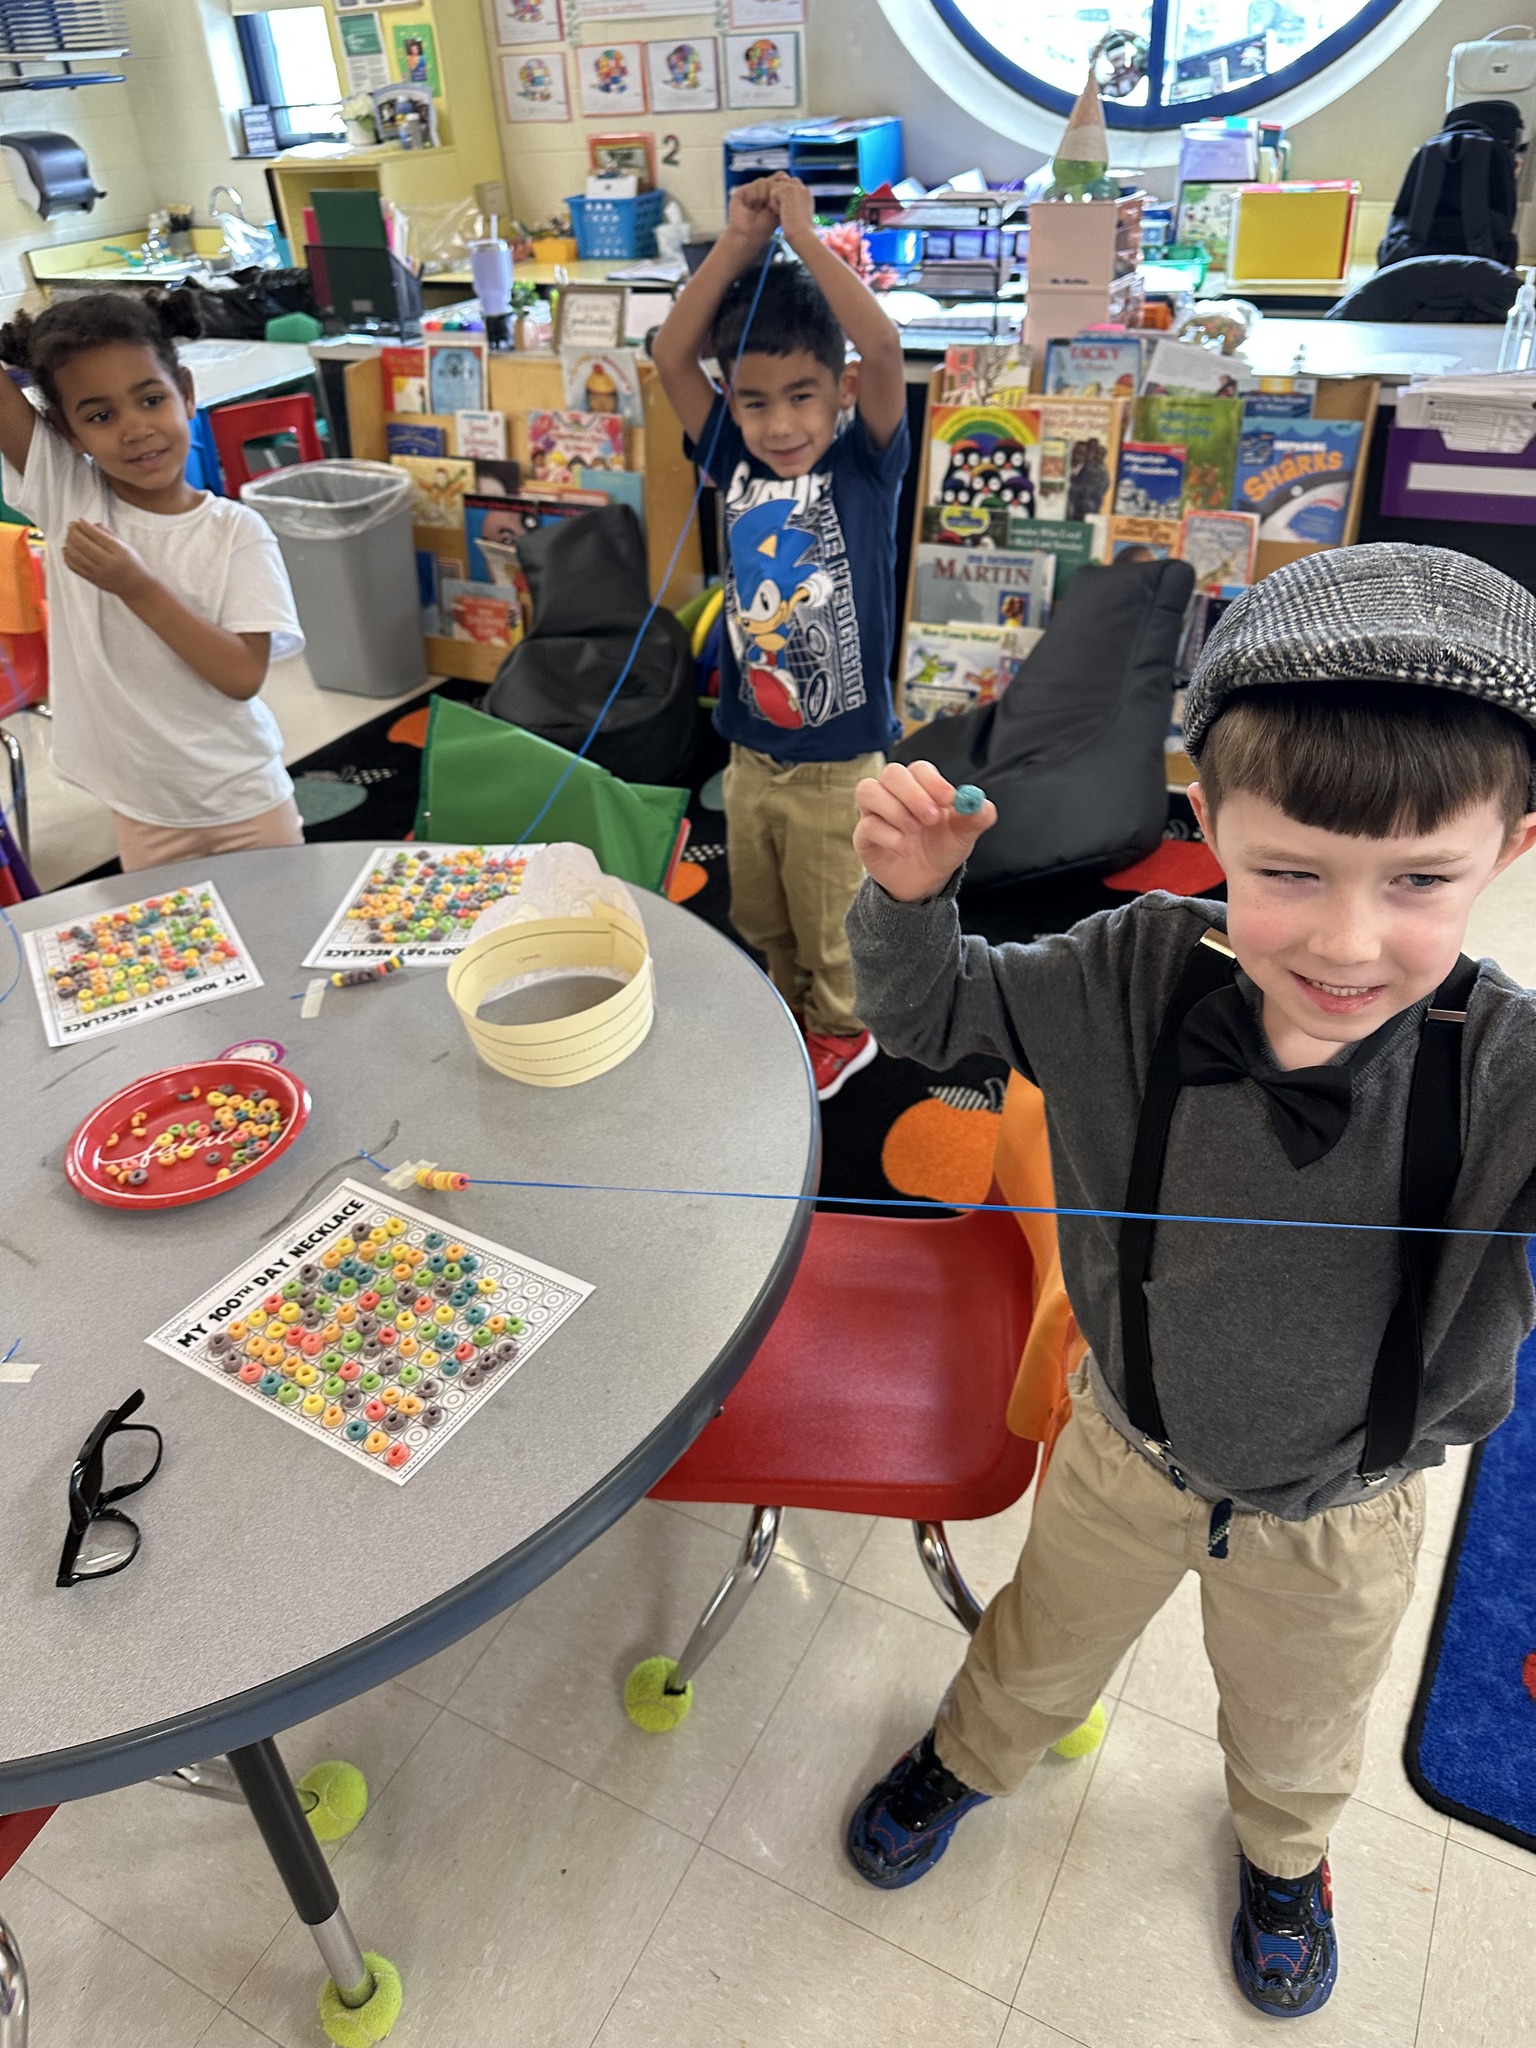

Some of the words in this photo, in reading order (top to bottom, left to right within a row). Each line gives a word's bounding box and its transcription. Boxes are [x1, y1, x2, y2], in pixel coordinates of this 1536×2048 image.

[663, 134, 680, 166] 2
[1069, 345, 1123, 360] TACKY
[1243, 450, 1344, 502] SHARKS
[819, 498, 846, 558] THE
[932, 557, 1033, 586] MARTIN
[827, 556, 868, 712] HEDGEHOG
[324, 948, 391, 957] NECKLACE
[225, 973, 247, 986] MY
[144, 994, 174, 1010] DAY
[63, 1005, 138, 1033] NECKLACE
[177, 1323, 208, 1347] MY
[253, 1258, 290, 1287] DAY
[288, 1199, 365, 1259] NECKLACE
